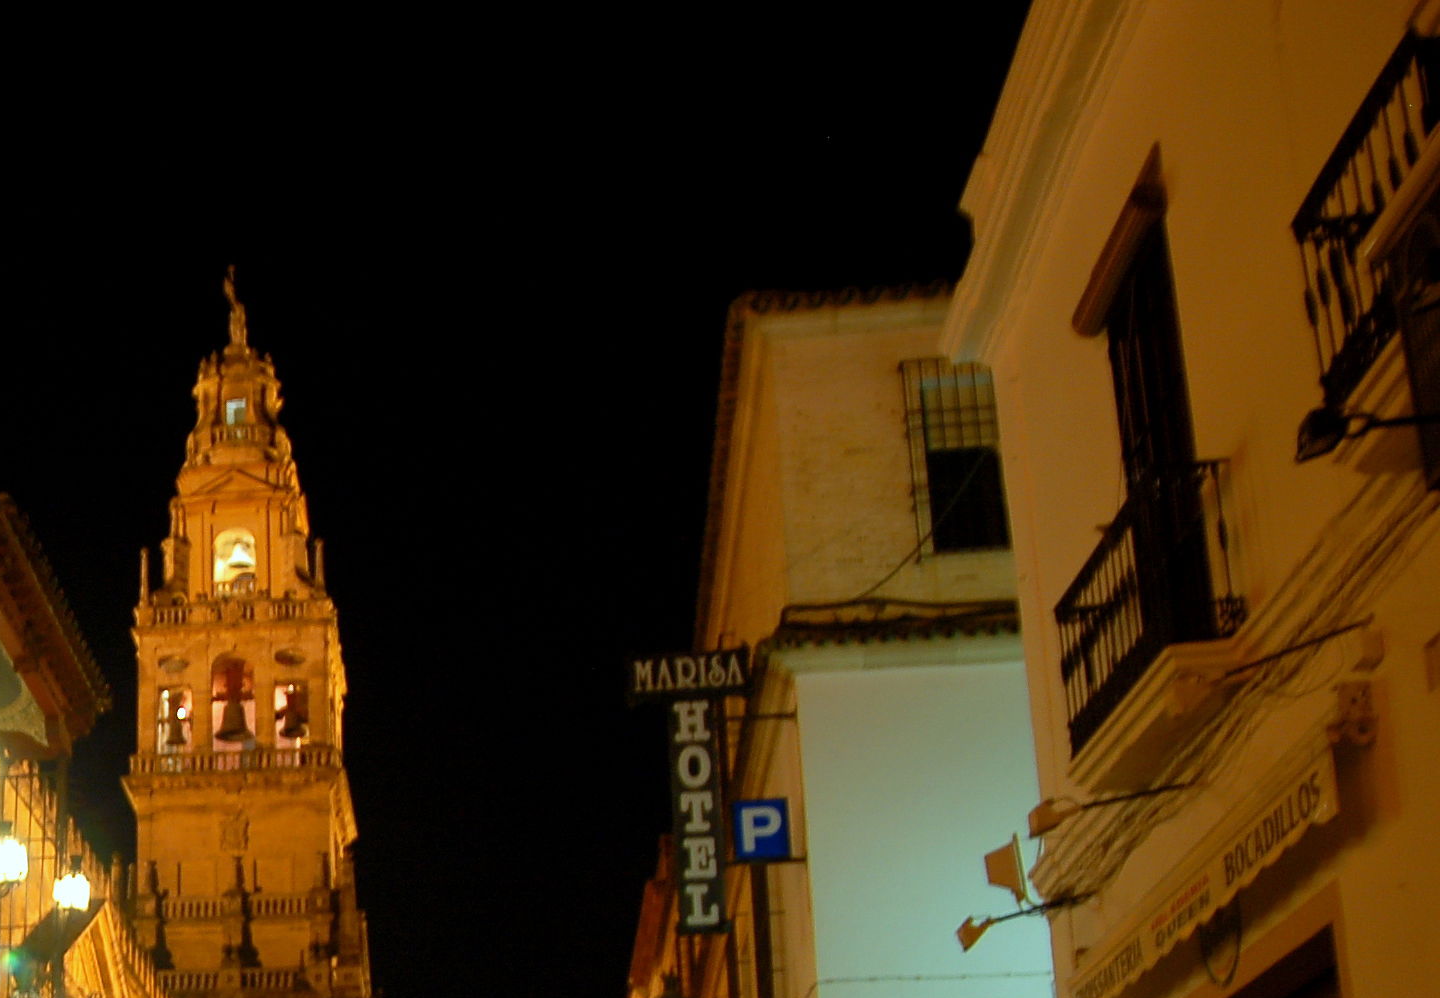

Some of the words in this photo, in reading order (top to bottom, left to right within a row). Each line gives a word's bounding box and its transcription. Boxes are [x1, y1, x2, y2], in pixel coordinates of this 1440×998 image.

[634, 653, 744, 692] MARISA
[673, 700, 720, 927] HOTEL
[741, 806, 782, 854] P
[1222, 771, 1322, 887] BOCADILLOS
